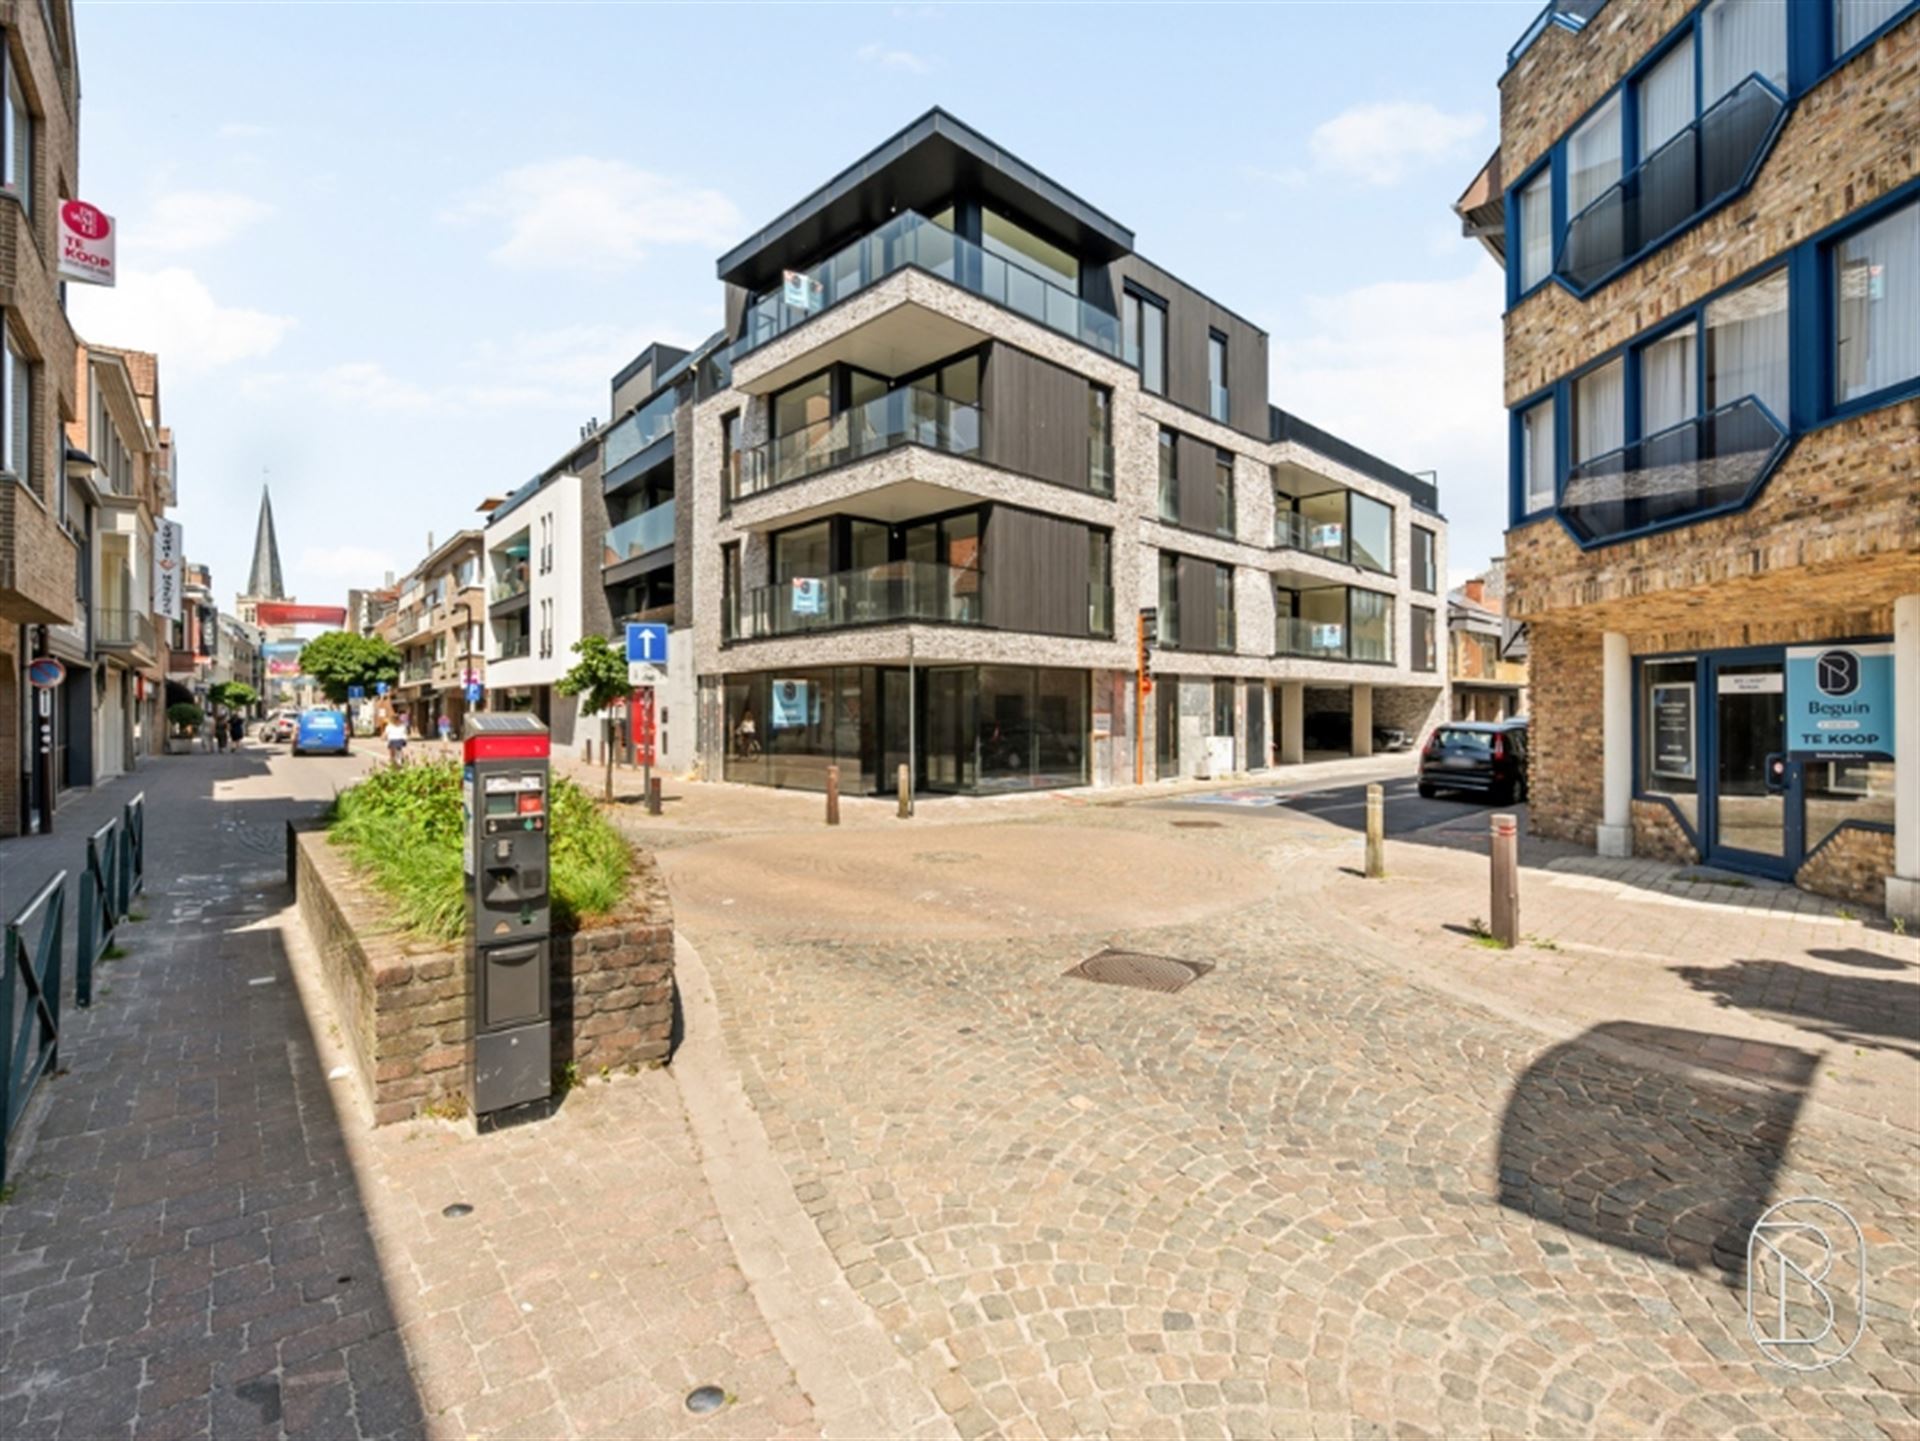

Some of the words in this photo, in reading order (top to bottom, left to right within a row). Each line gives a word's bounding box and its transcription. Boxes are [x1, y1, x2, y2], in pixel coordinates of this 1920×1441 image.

[65, 234, 84, 250] TE
[65, 247, 111, 268] KOOP
[1808, 700, 1871, 718] Beguin
[1802, 734, 1823, 744] TE
[1828, 734, 1880, 744] KOOP
